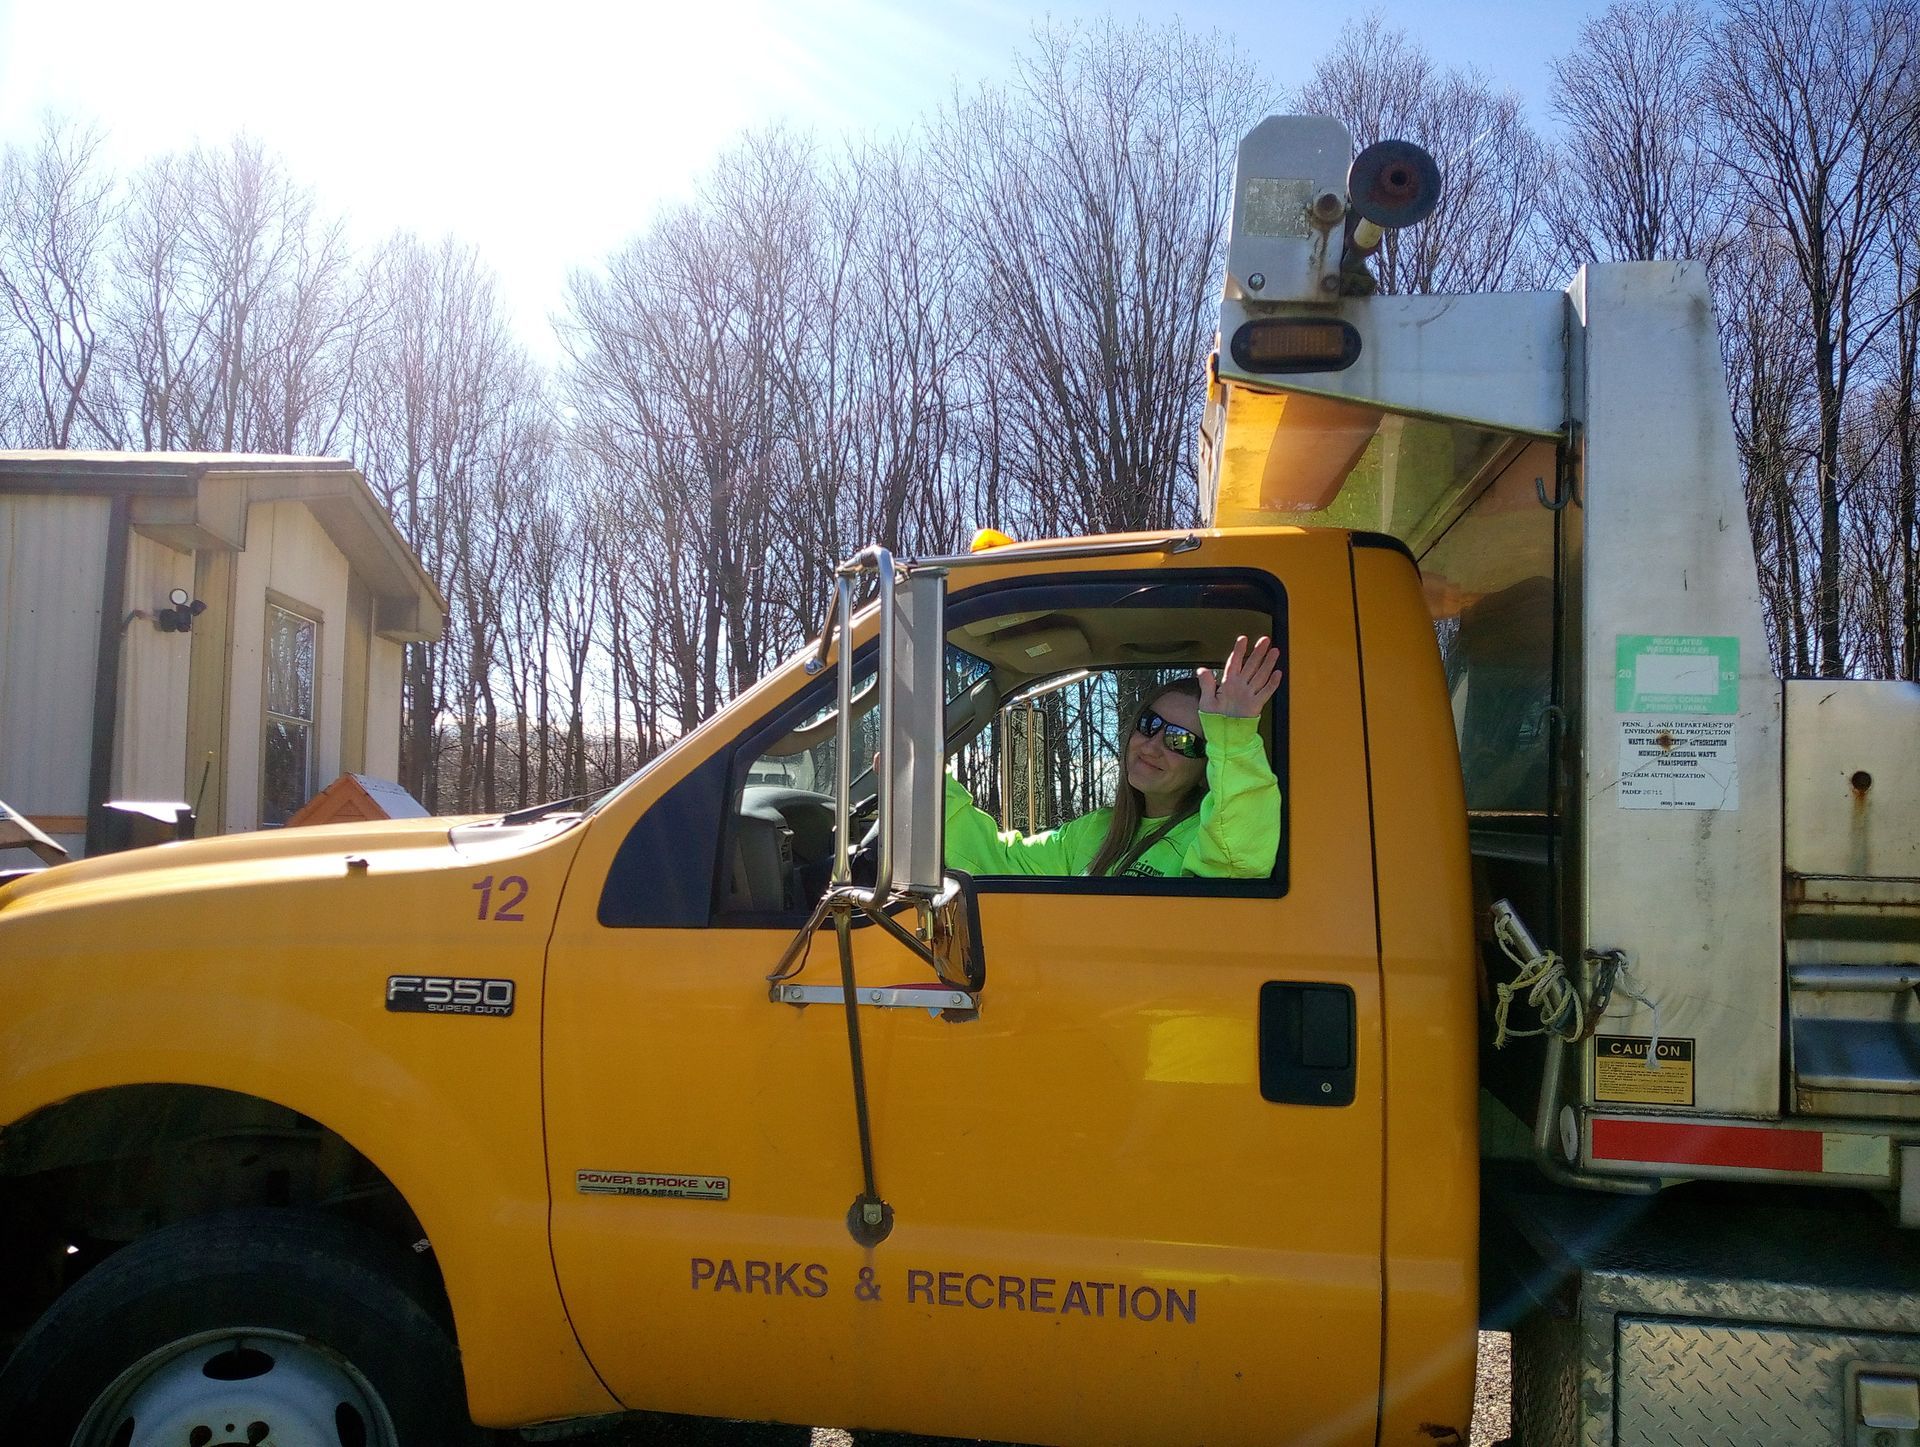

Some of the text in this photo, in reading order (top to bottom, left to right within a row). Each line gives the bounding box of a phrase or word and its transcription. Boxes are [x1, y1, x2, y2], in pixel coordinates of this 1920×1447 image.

[1618, 669, 1632, 678] 20
[1628, 738, 1645, 746] WASTE
[1657, 759, 1698, 767] TRANSPORTER
[472, 875, 529, 922] 12
[428, 1003, 511, 1014] SUPER DUTY
[1610, 1042, 1680, 1057] CAUTON
[578, 1173, 726, 1189] POWER STROKE V8
[617, 1186, 686, 1198] TURBO DIESEL
[691, 1257, 1198, 1325] PARKS & RECREATION
